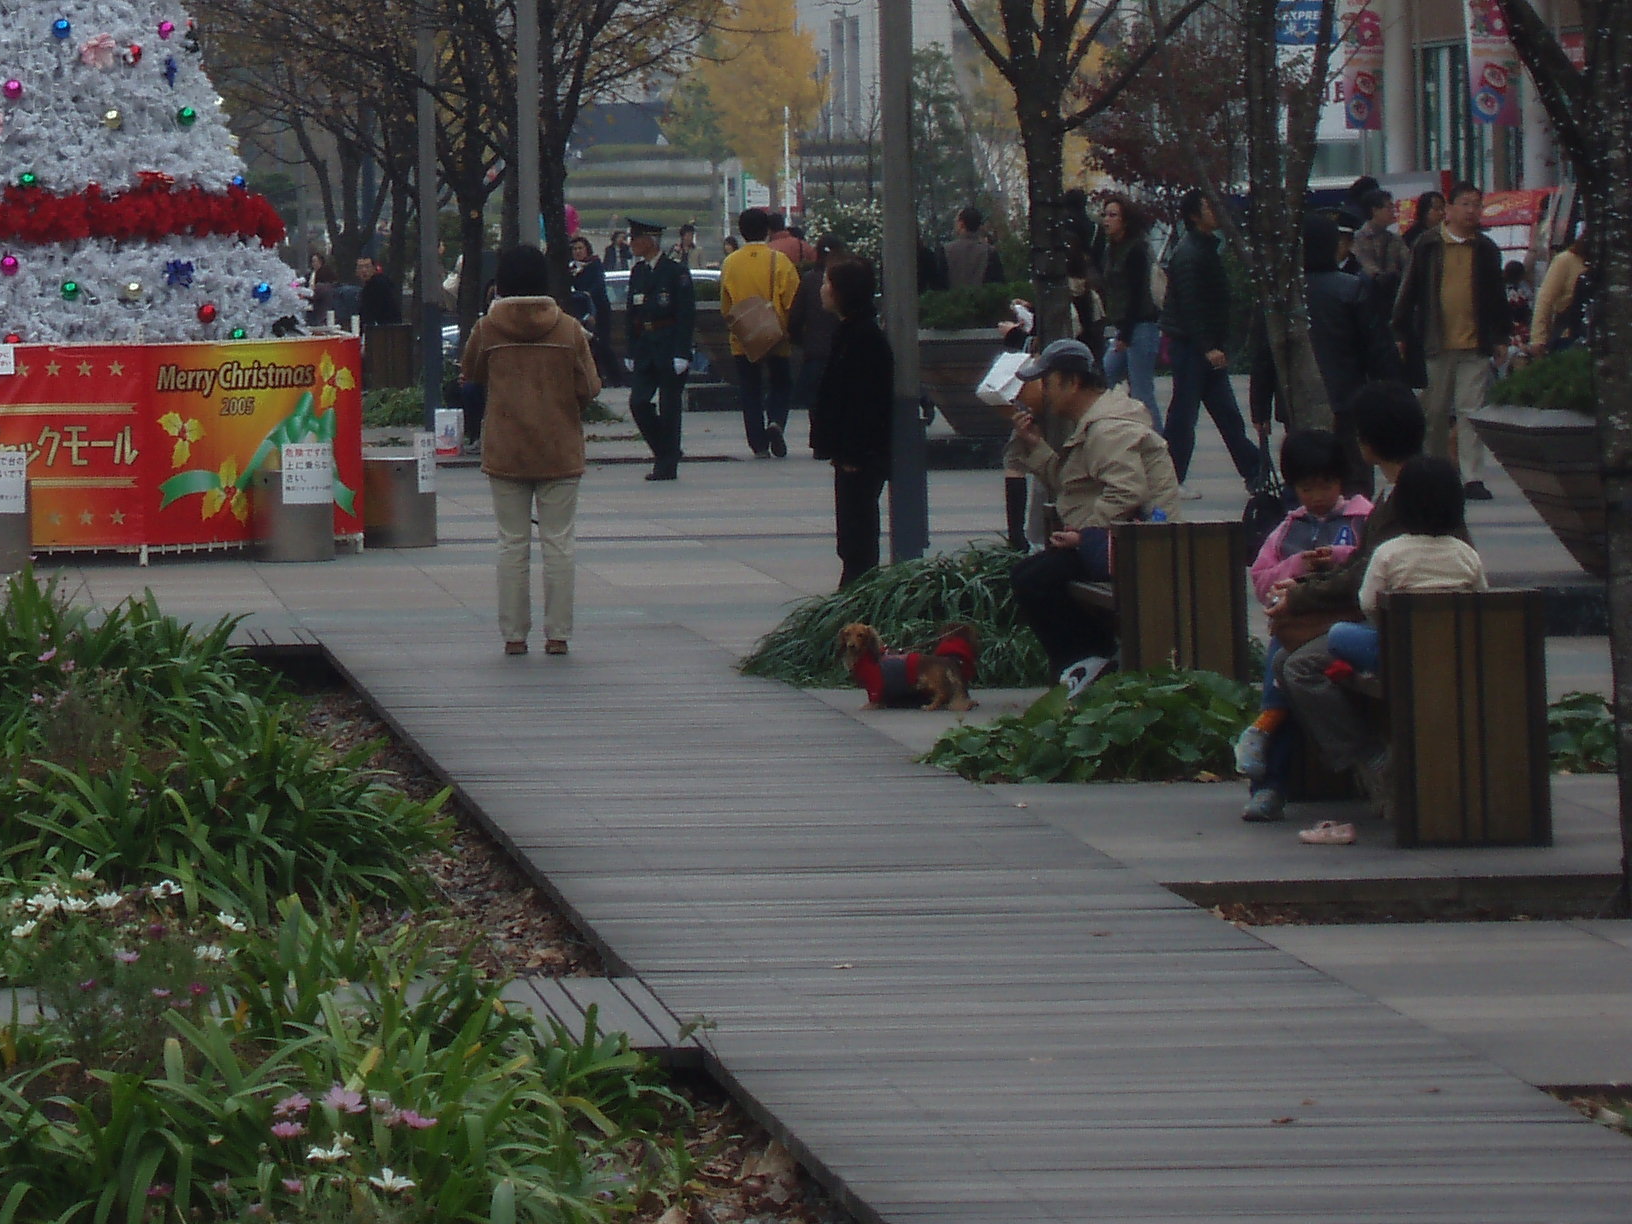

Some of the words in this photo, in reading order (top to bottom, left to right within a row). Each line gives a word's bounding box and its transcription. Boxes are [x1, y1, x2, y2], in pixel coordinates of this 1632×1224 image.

[156, 364, 217, 397] Merry
[218, 360, 315, 389] Christmas
[220, 397, 255, 415] 2005
